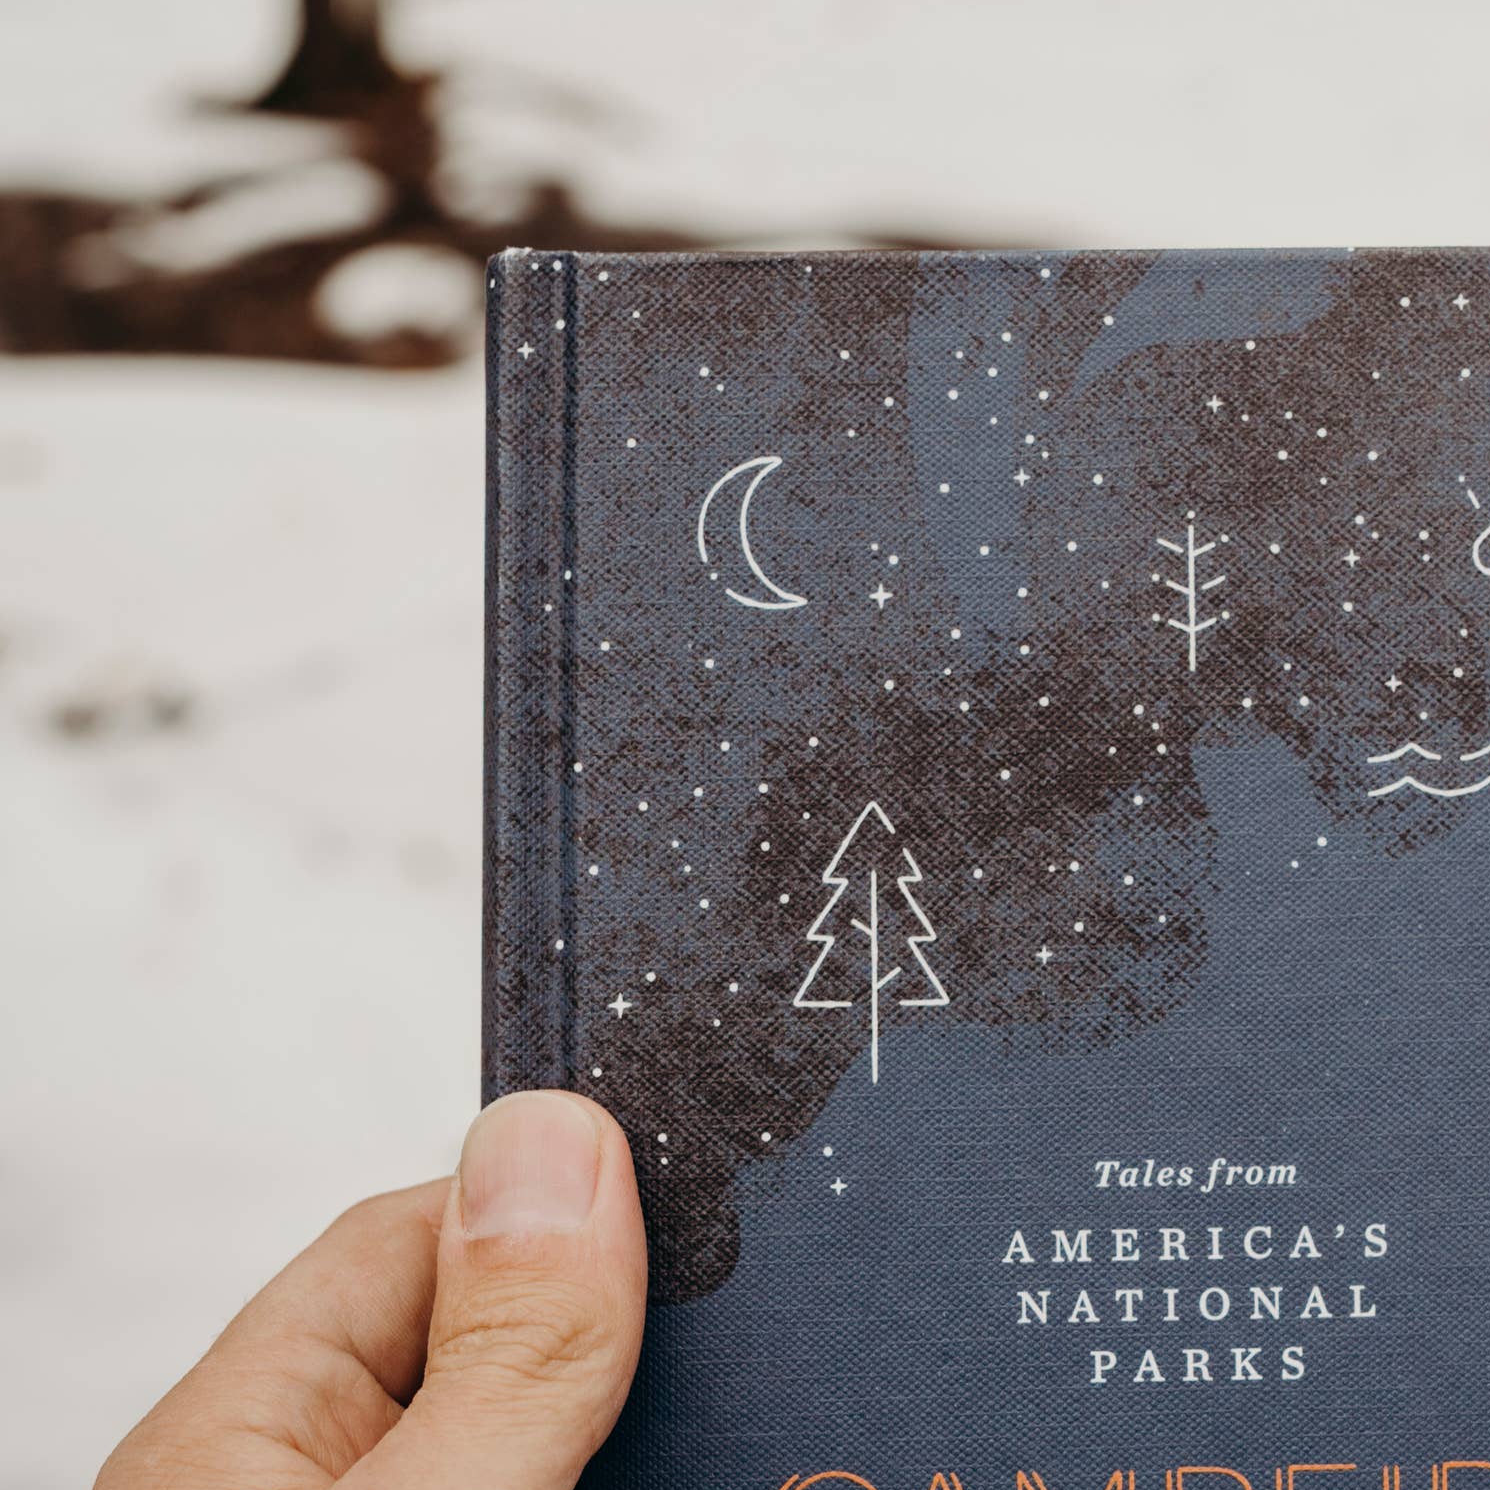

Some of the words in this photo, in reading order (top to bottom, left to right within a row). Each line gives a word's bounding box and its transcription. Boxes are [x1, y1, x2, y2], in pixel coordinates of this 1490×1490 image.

[1095, 1159, 1194, 1188] Tales
[1200, 1157, 1296, 1193] from
[1001, 1223, 1388, 1263] AMERICA’S
[1017, 1285, 1376, 1324] NATIONAL
[1090, 1346, 1305, 1383] PARKS
